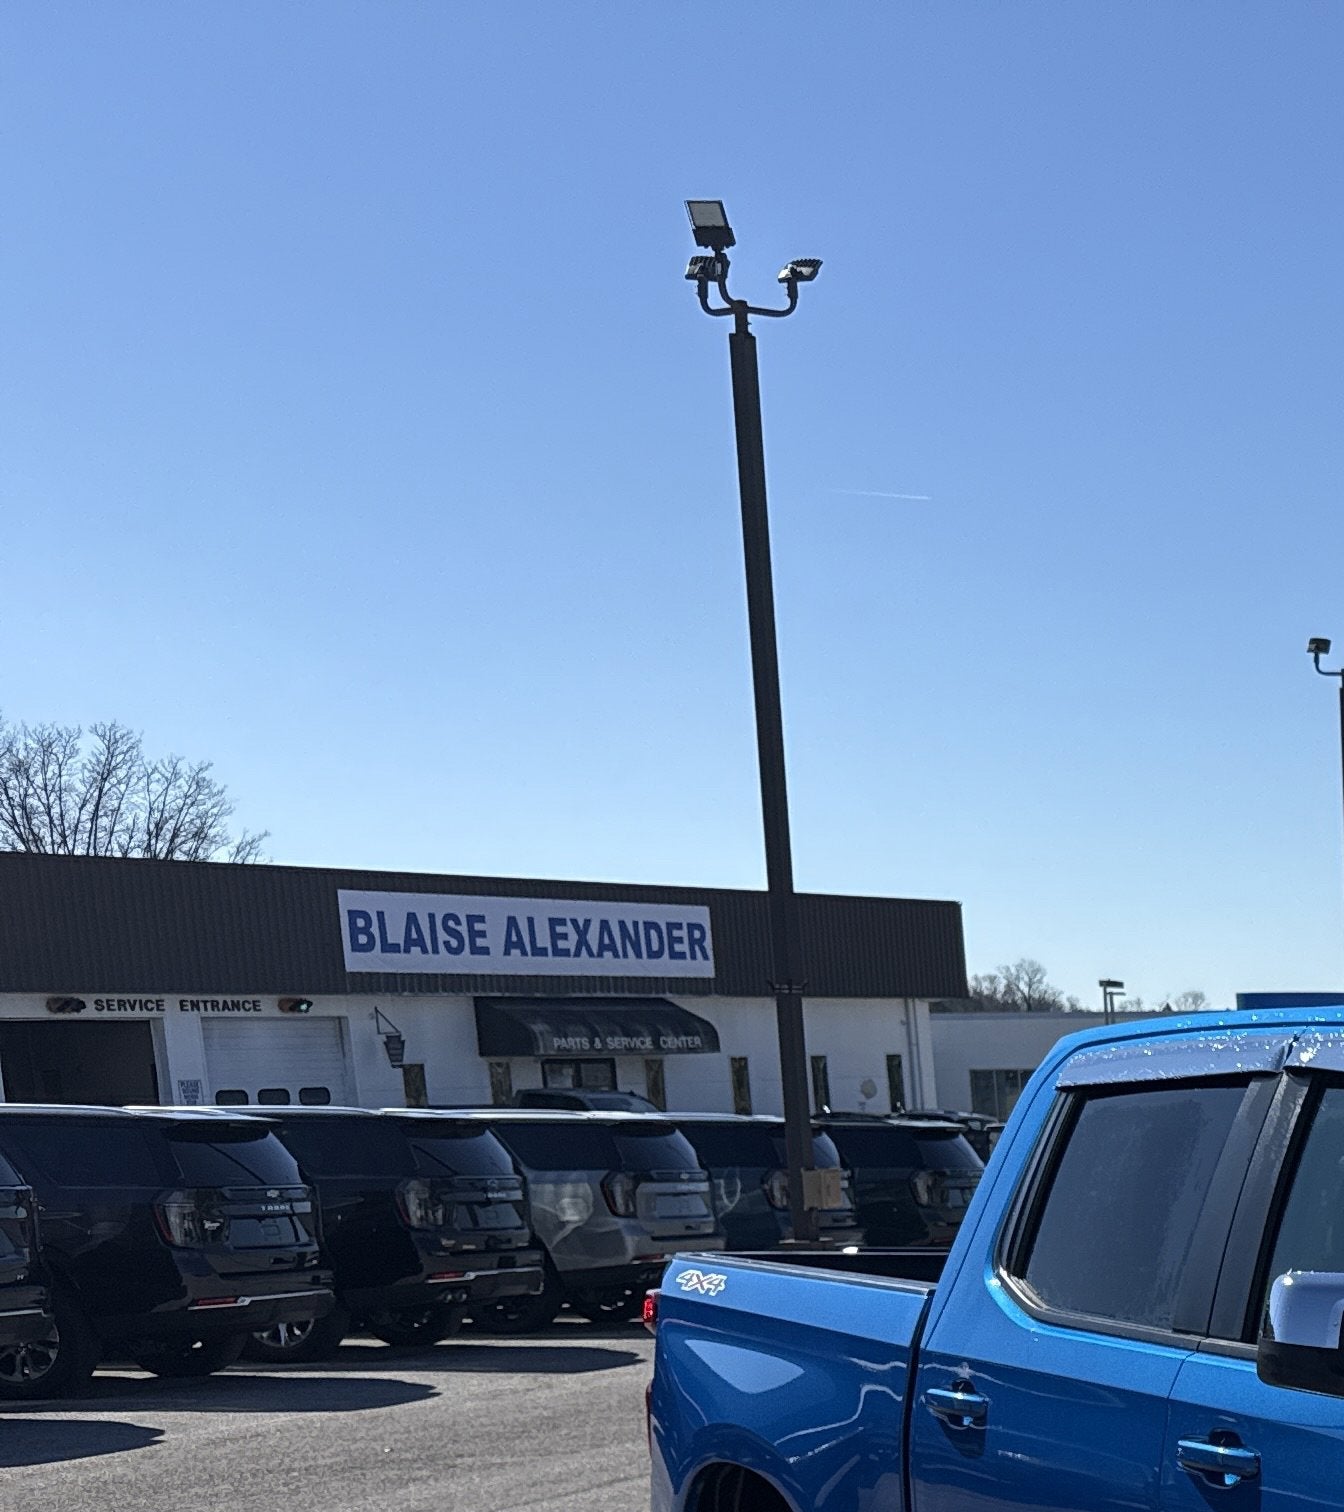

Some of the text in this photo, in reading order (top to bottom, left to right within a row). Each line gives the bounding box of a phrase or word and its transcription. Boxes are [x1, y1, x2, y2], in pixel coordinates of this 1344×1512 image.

[346, 909, 710, 962] BLAISE ALEXANDER
[94, 999, 262, 1012] SERVICE ENTRANCE
[553, 1036, 702, 1050] PARTS & SERVICE CENTER
